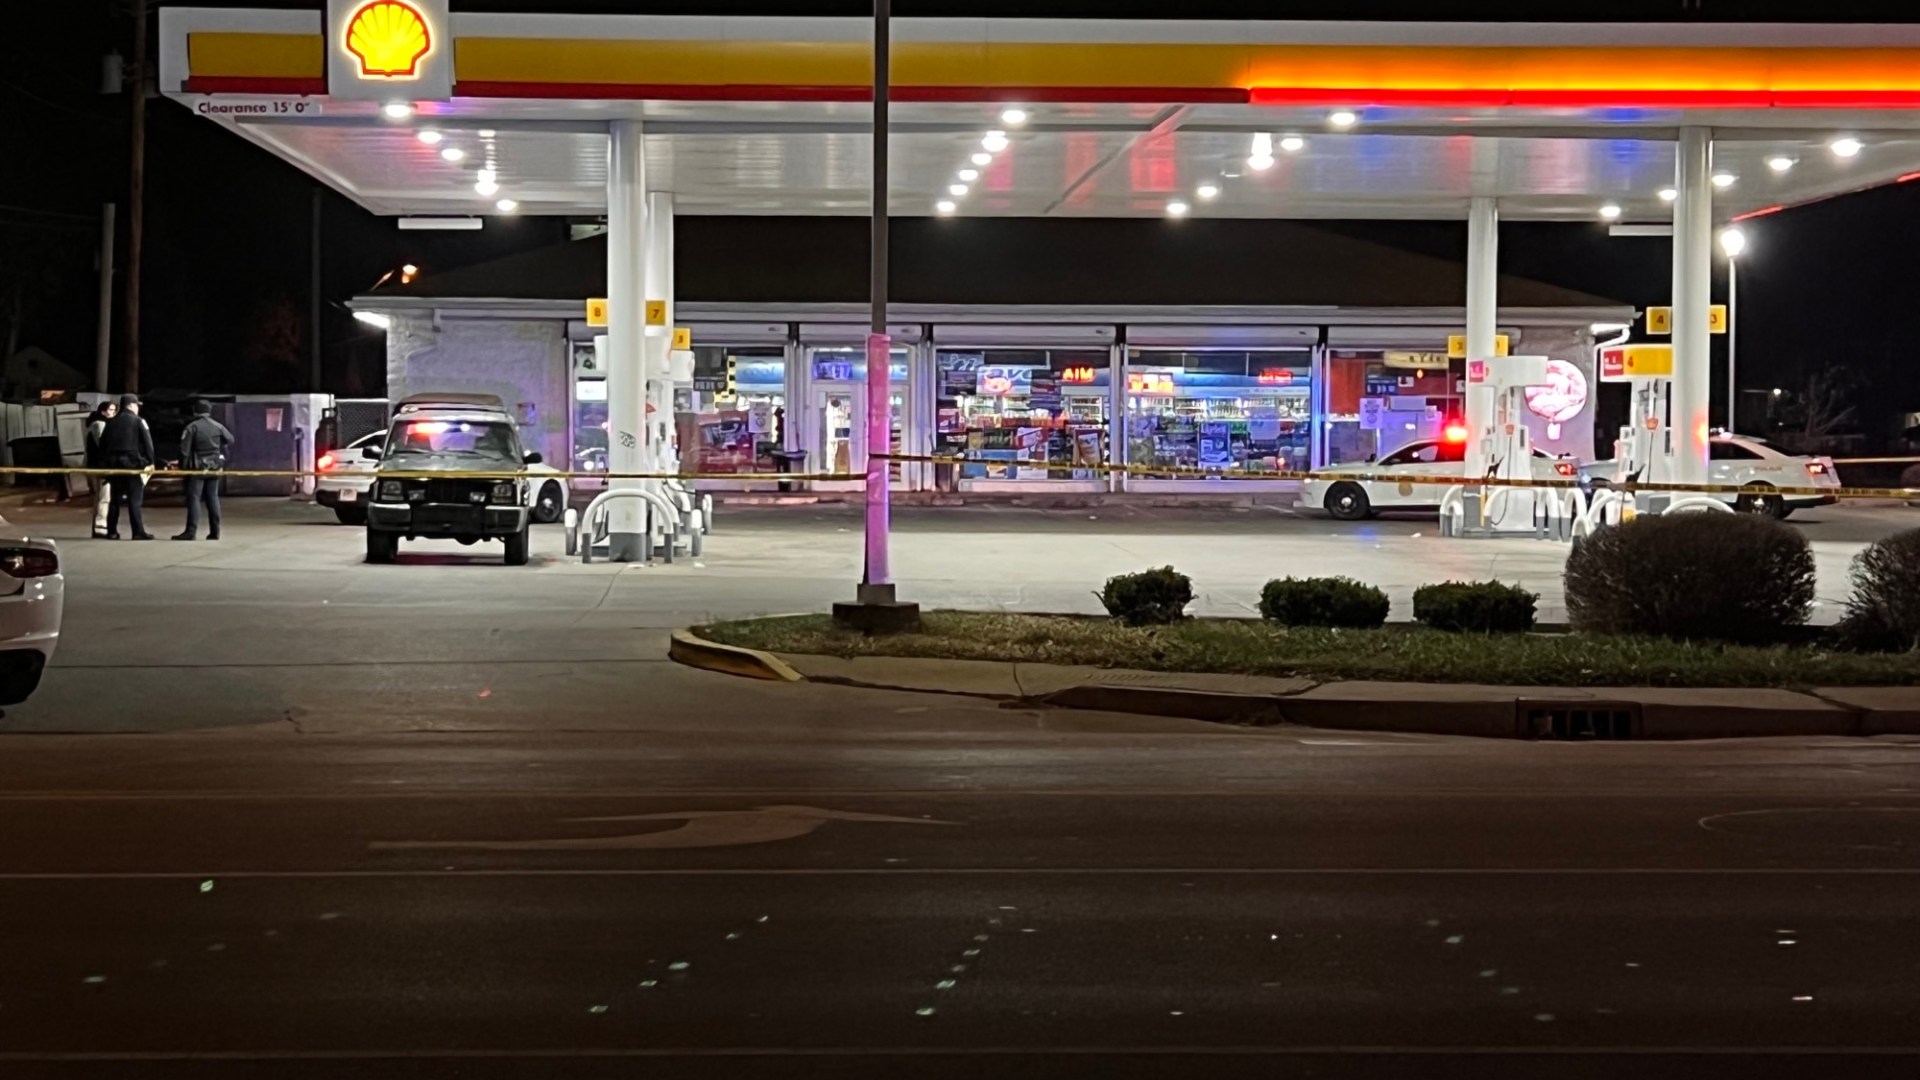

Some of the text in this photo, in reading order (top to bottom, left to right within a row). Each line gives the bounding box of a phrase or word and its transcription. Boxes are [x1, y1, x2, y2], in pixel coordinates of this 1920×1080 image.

[198, 101, 267, 114] Clearance
[594, 307, 602, 318] 8
[652, 309, 660, 319] 7
